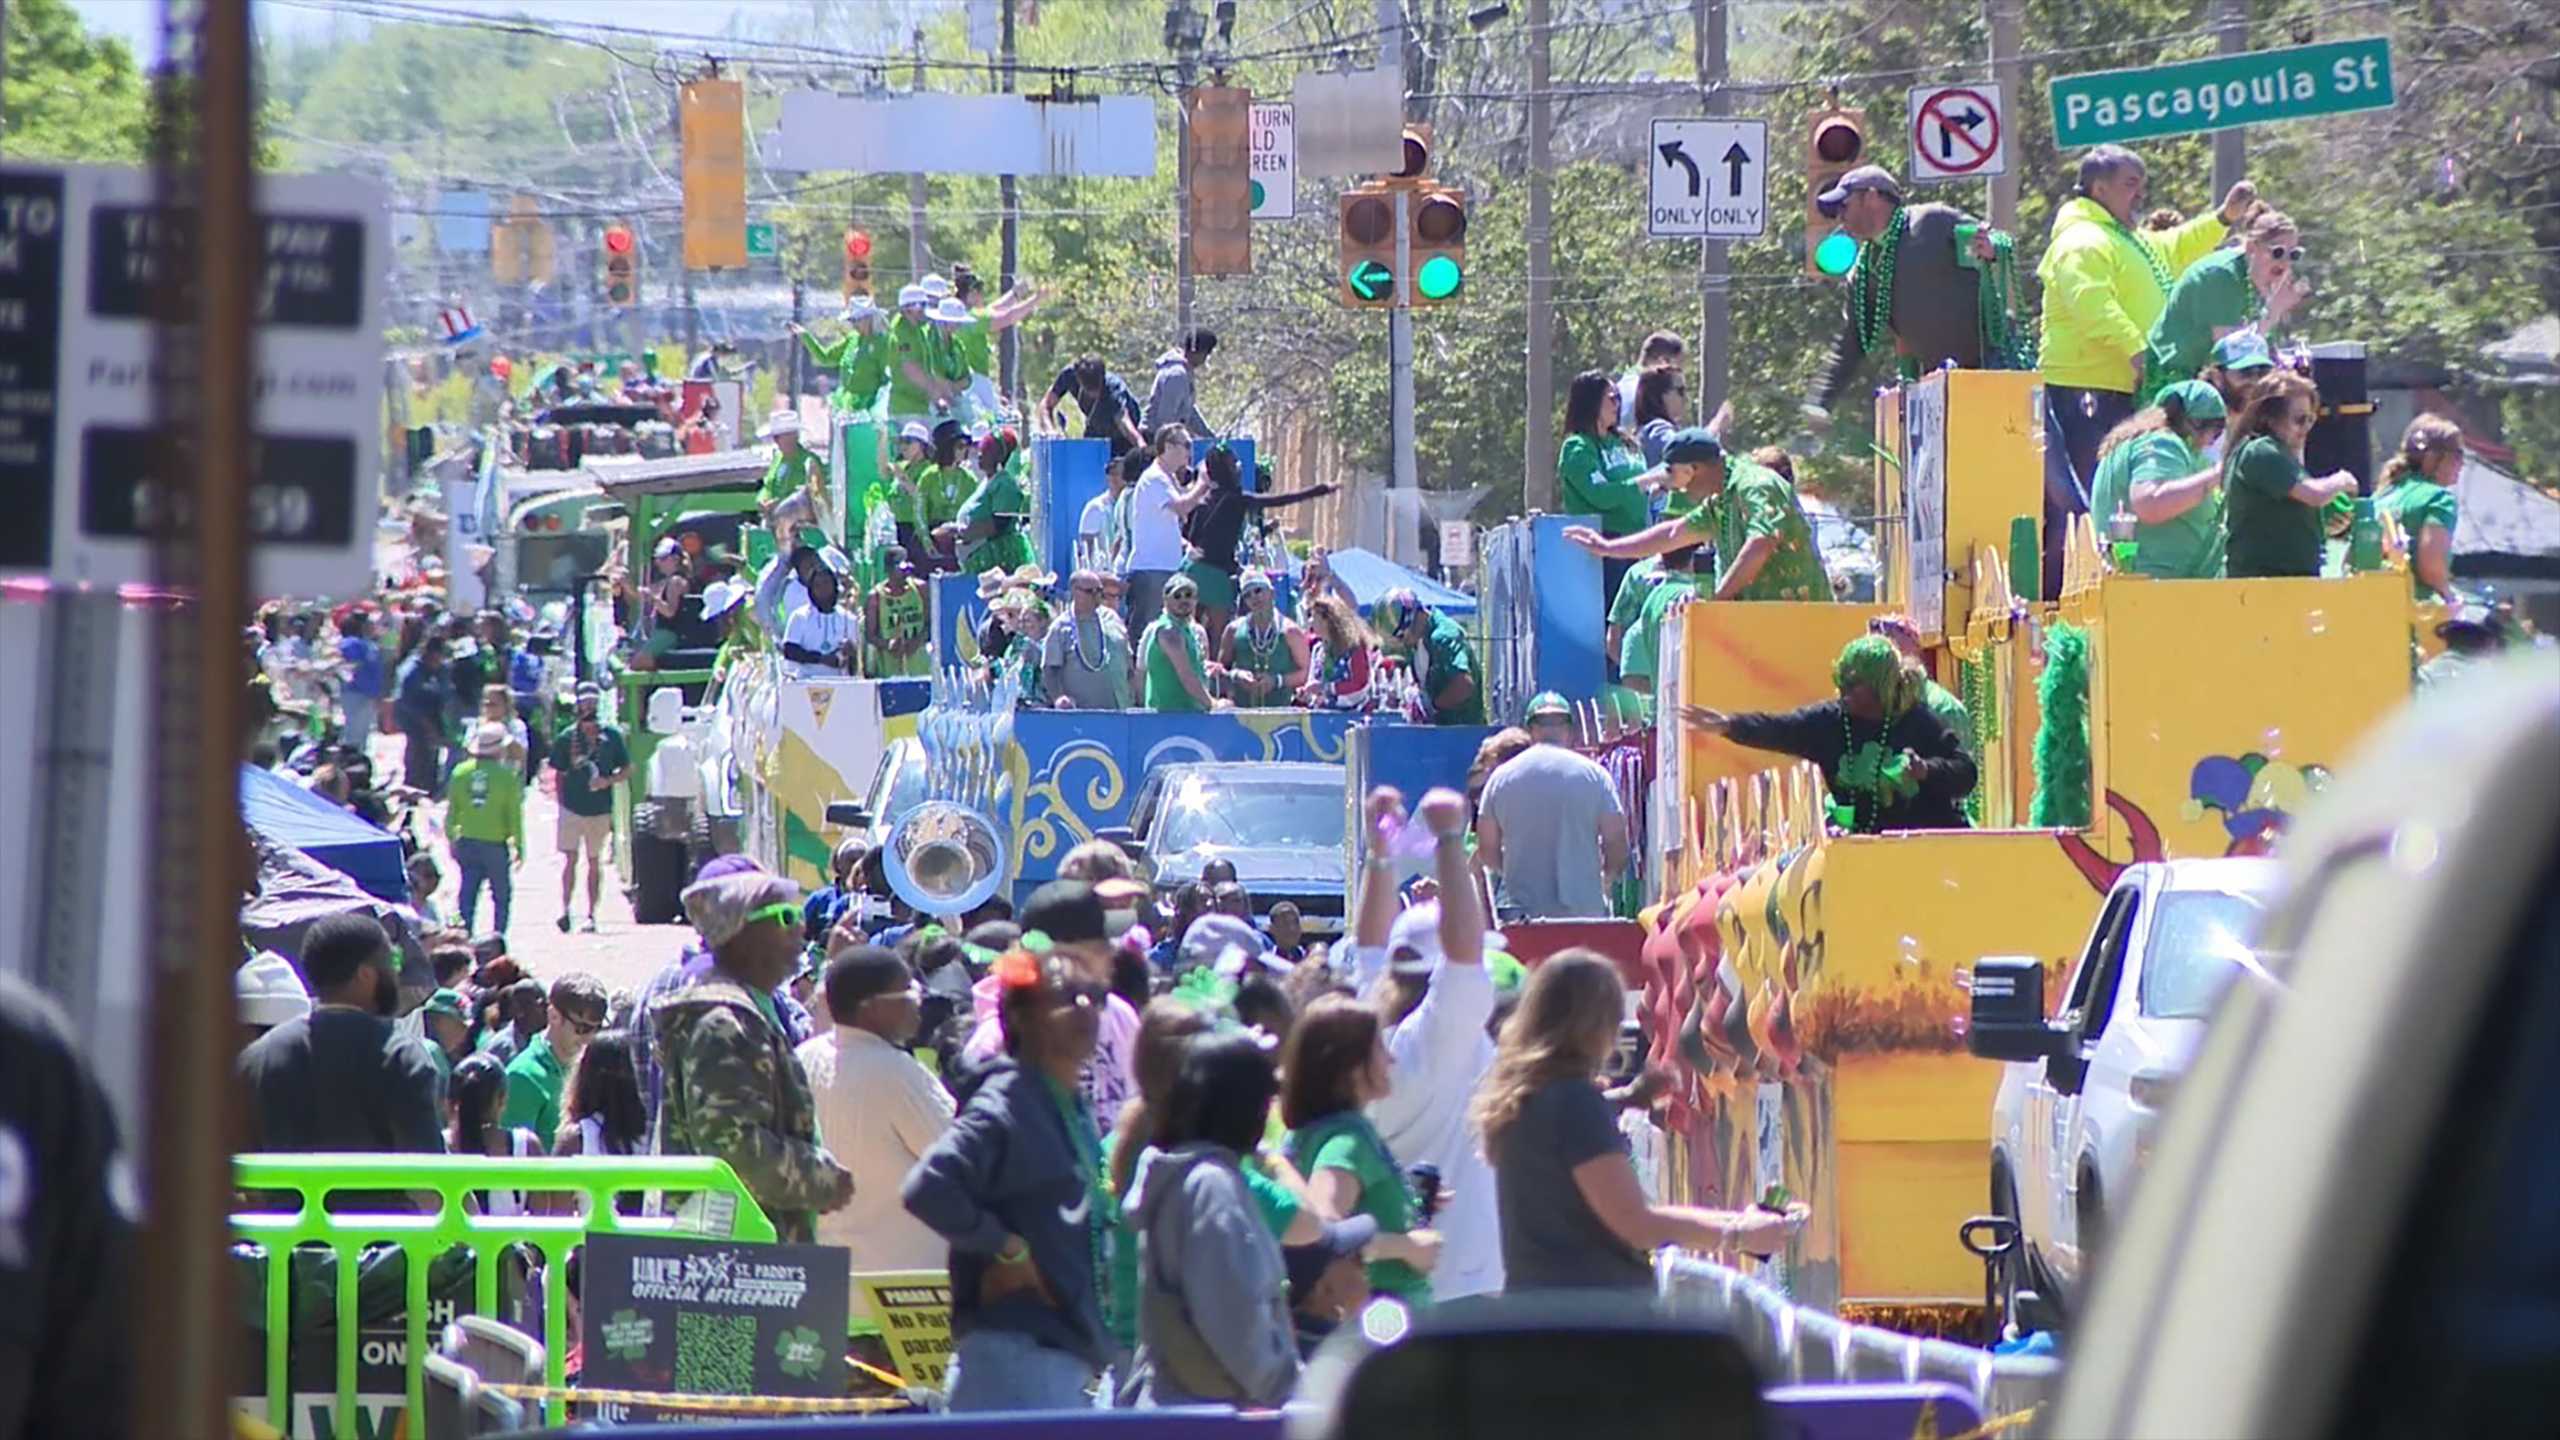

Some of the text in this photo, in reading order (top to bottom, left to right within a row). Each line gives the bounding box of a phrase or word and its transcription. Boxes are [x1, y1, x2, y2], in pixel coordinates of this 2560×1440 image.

[2066, 55, 2379, 130] Pascagoula St
[1254, 109, 1291, 127] TURN
[1253, 153, 1287, 171] REEN
[1654, 207, 1702, 225] ONLY
[1710, 208, 1759, 225] ONLY
[755, 1264, 807, 1281] PADDY'S
[632, 1282, 701, 1303] OFFICIAL
[703, 1286, 804, 1309] AFTERPARTY
[887, 1312, 914, 1329] No
[912, 1363, 927, 1381] 5
